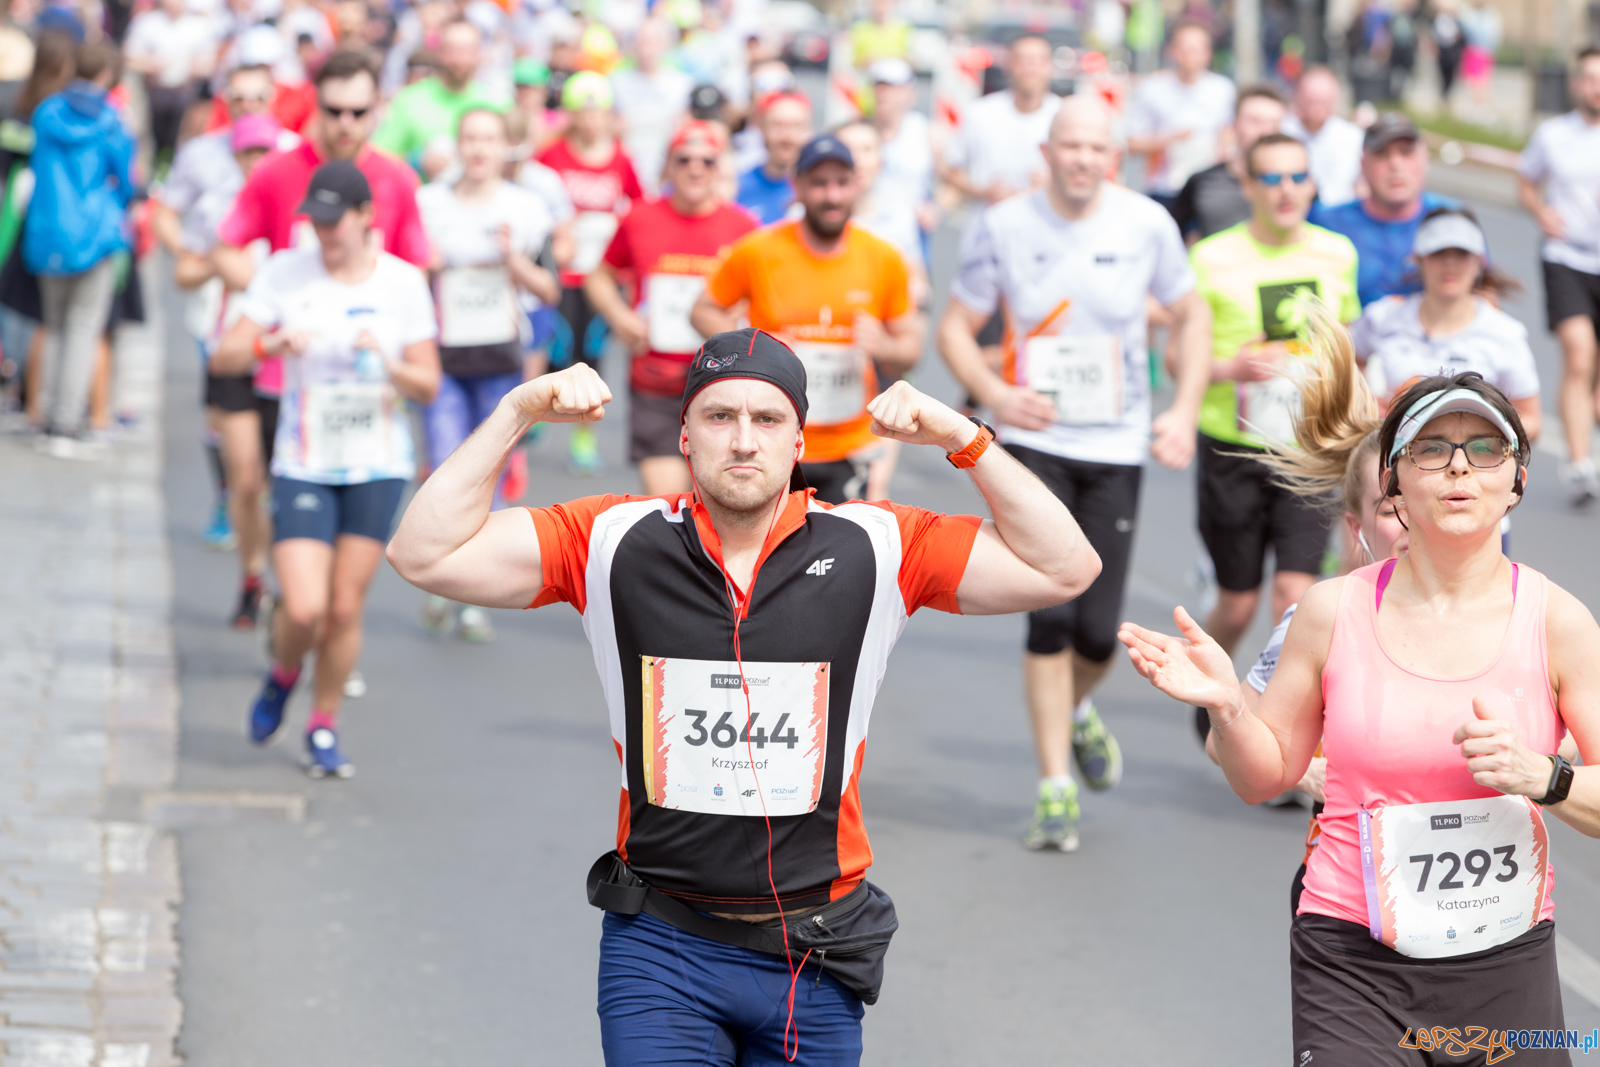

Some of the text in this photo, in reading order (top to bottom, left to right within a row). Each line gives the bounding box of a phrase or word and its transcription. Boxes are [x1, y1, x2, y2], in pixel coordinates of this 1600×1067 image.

[805, 557, 835, 576] 4F
[684, 708, 799, 749] 3644
[741, 788, 757, 797] 4F
[1409, 844, 1519, 893] 7293
[1436, 894, 1500, 911] Katarzyna
[1473, 925, 1488, 934] 4F
